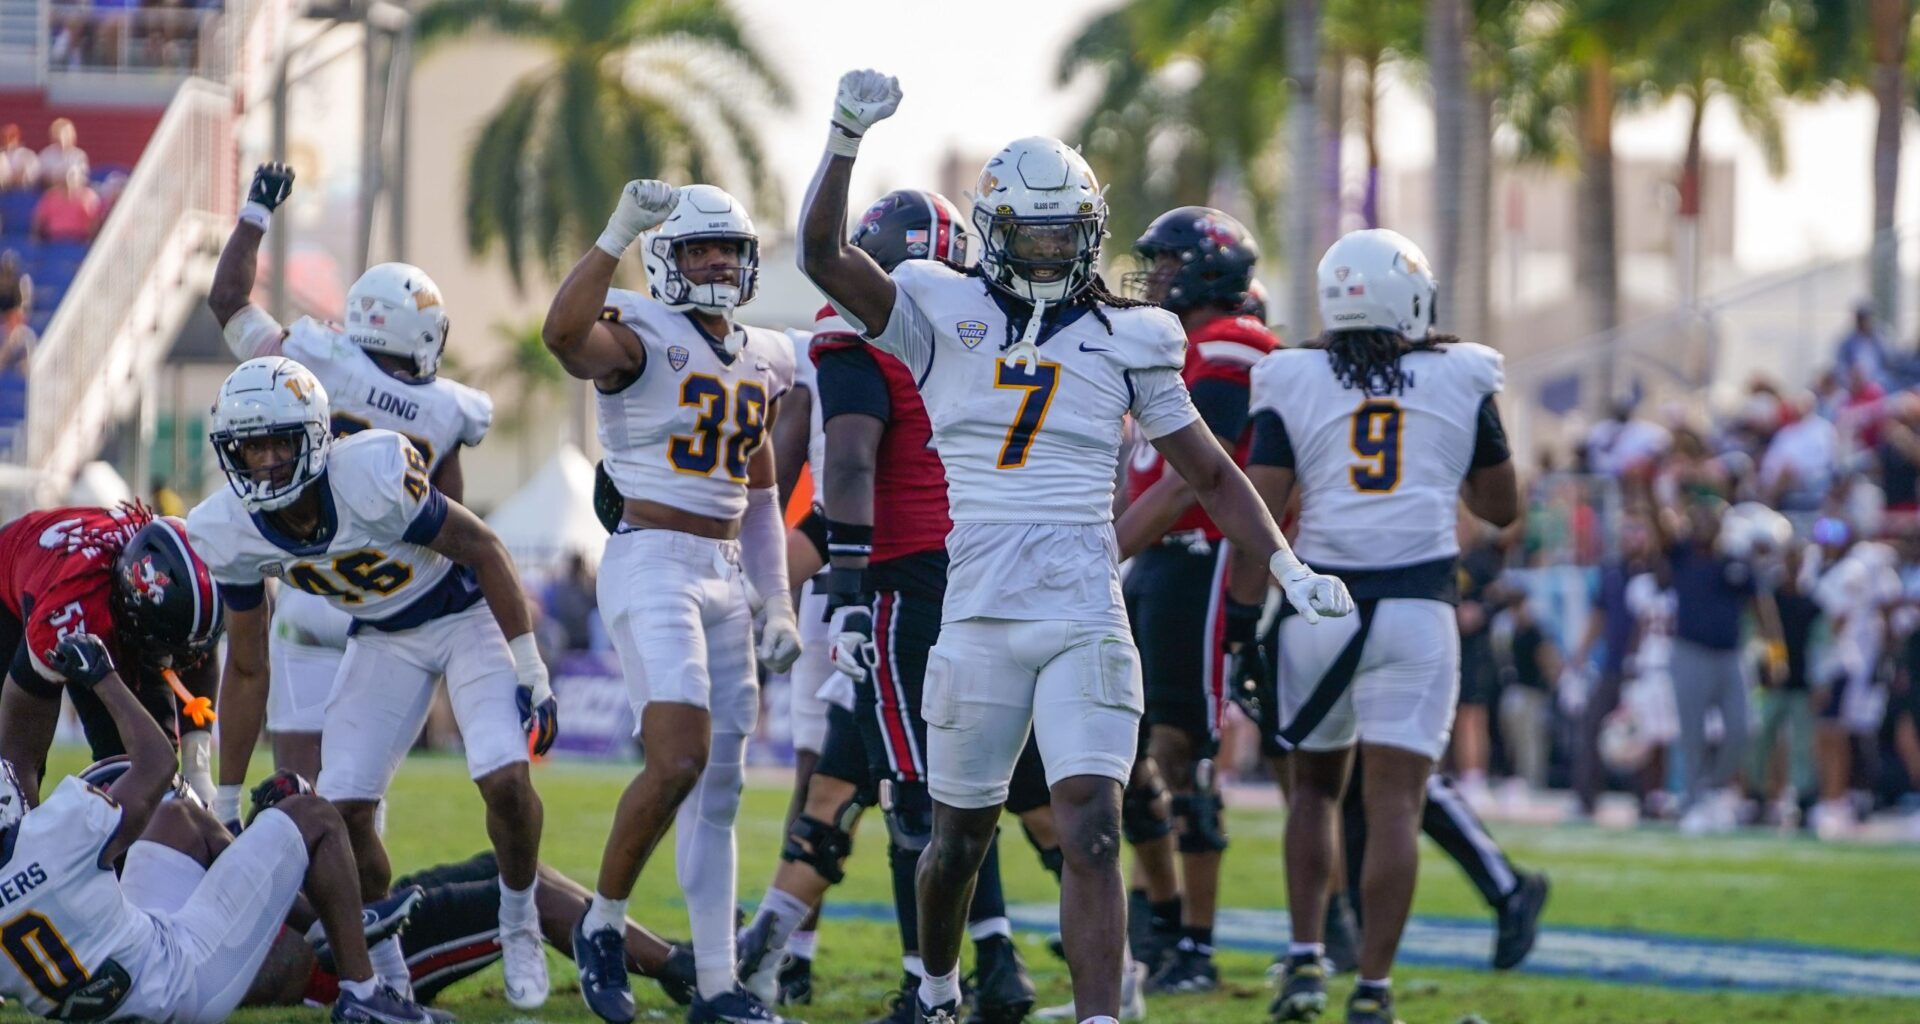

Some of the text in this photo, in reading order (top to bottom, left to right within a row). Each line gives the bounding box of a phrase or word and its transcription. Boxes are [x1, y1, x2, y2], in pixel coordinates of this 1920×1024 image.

[366, 386, 419, 421] LONG
[667, 372, 768, 484] 38
[994, 357, 1061, 470] 7
[403, 447, 428, 504] 46
[1348, 398, 1405, 494] 9
[289, 548, 414, 604] 46
[0, 861, 48, 909] ERS
[0, 908, 92, 1006] 0
